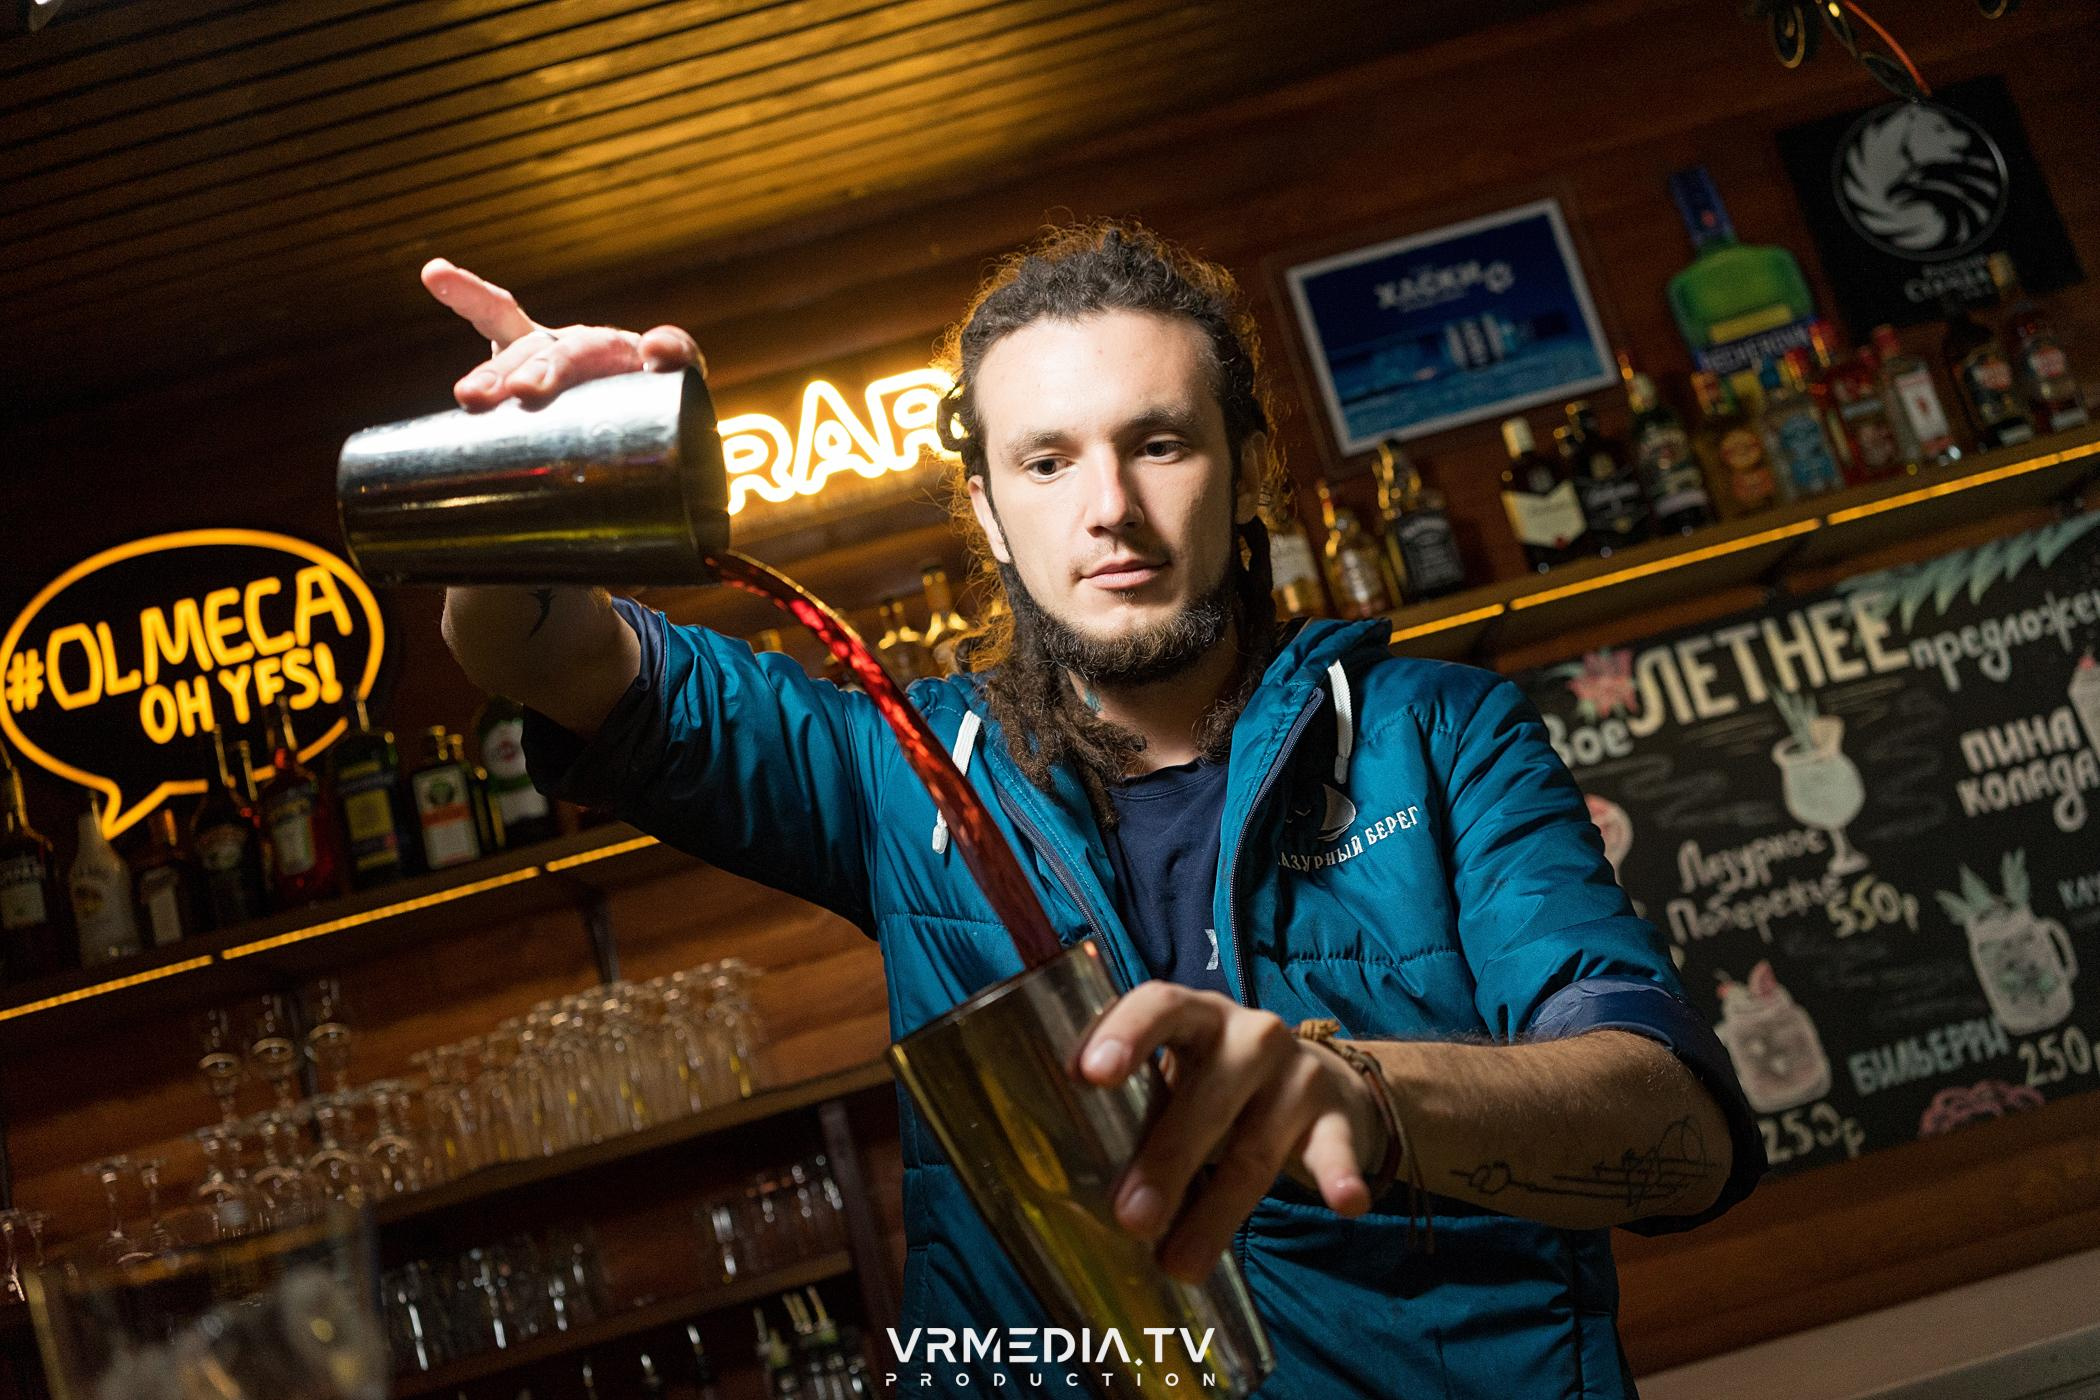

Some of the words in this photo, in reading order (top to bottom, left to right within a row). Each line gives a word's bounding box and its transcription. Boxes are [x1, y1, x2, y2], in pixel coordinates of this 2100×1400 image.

[6, 565, 353, 712] #OLMECA
[1628, 591, 1911, 738] ЛЕТНЕЕ
[1909, 588, 2100, 692] предложе
[140, 675, 215, 744] OH
[1277, 835, 1364, 873] АЗУРНЫЙ
[1364, 805, 1419, 845] БЕРЕГ
